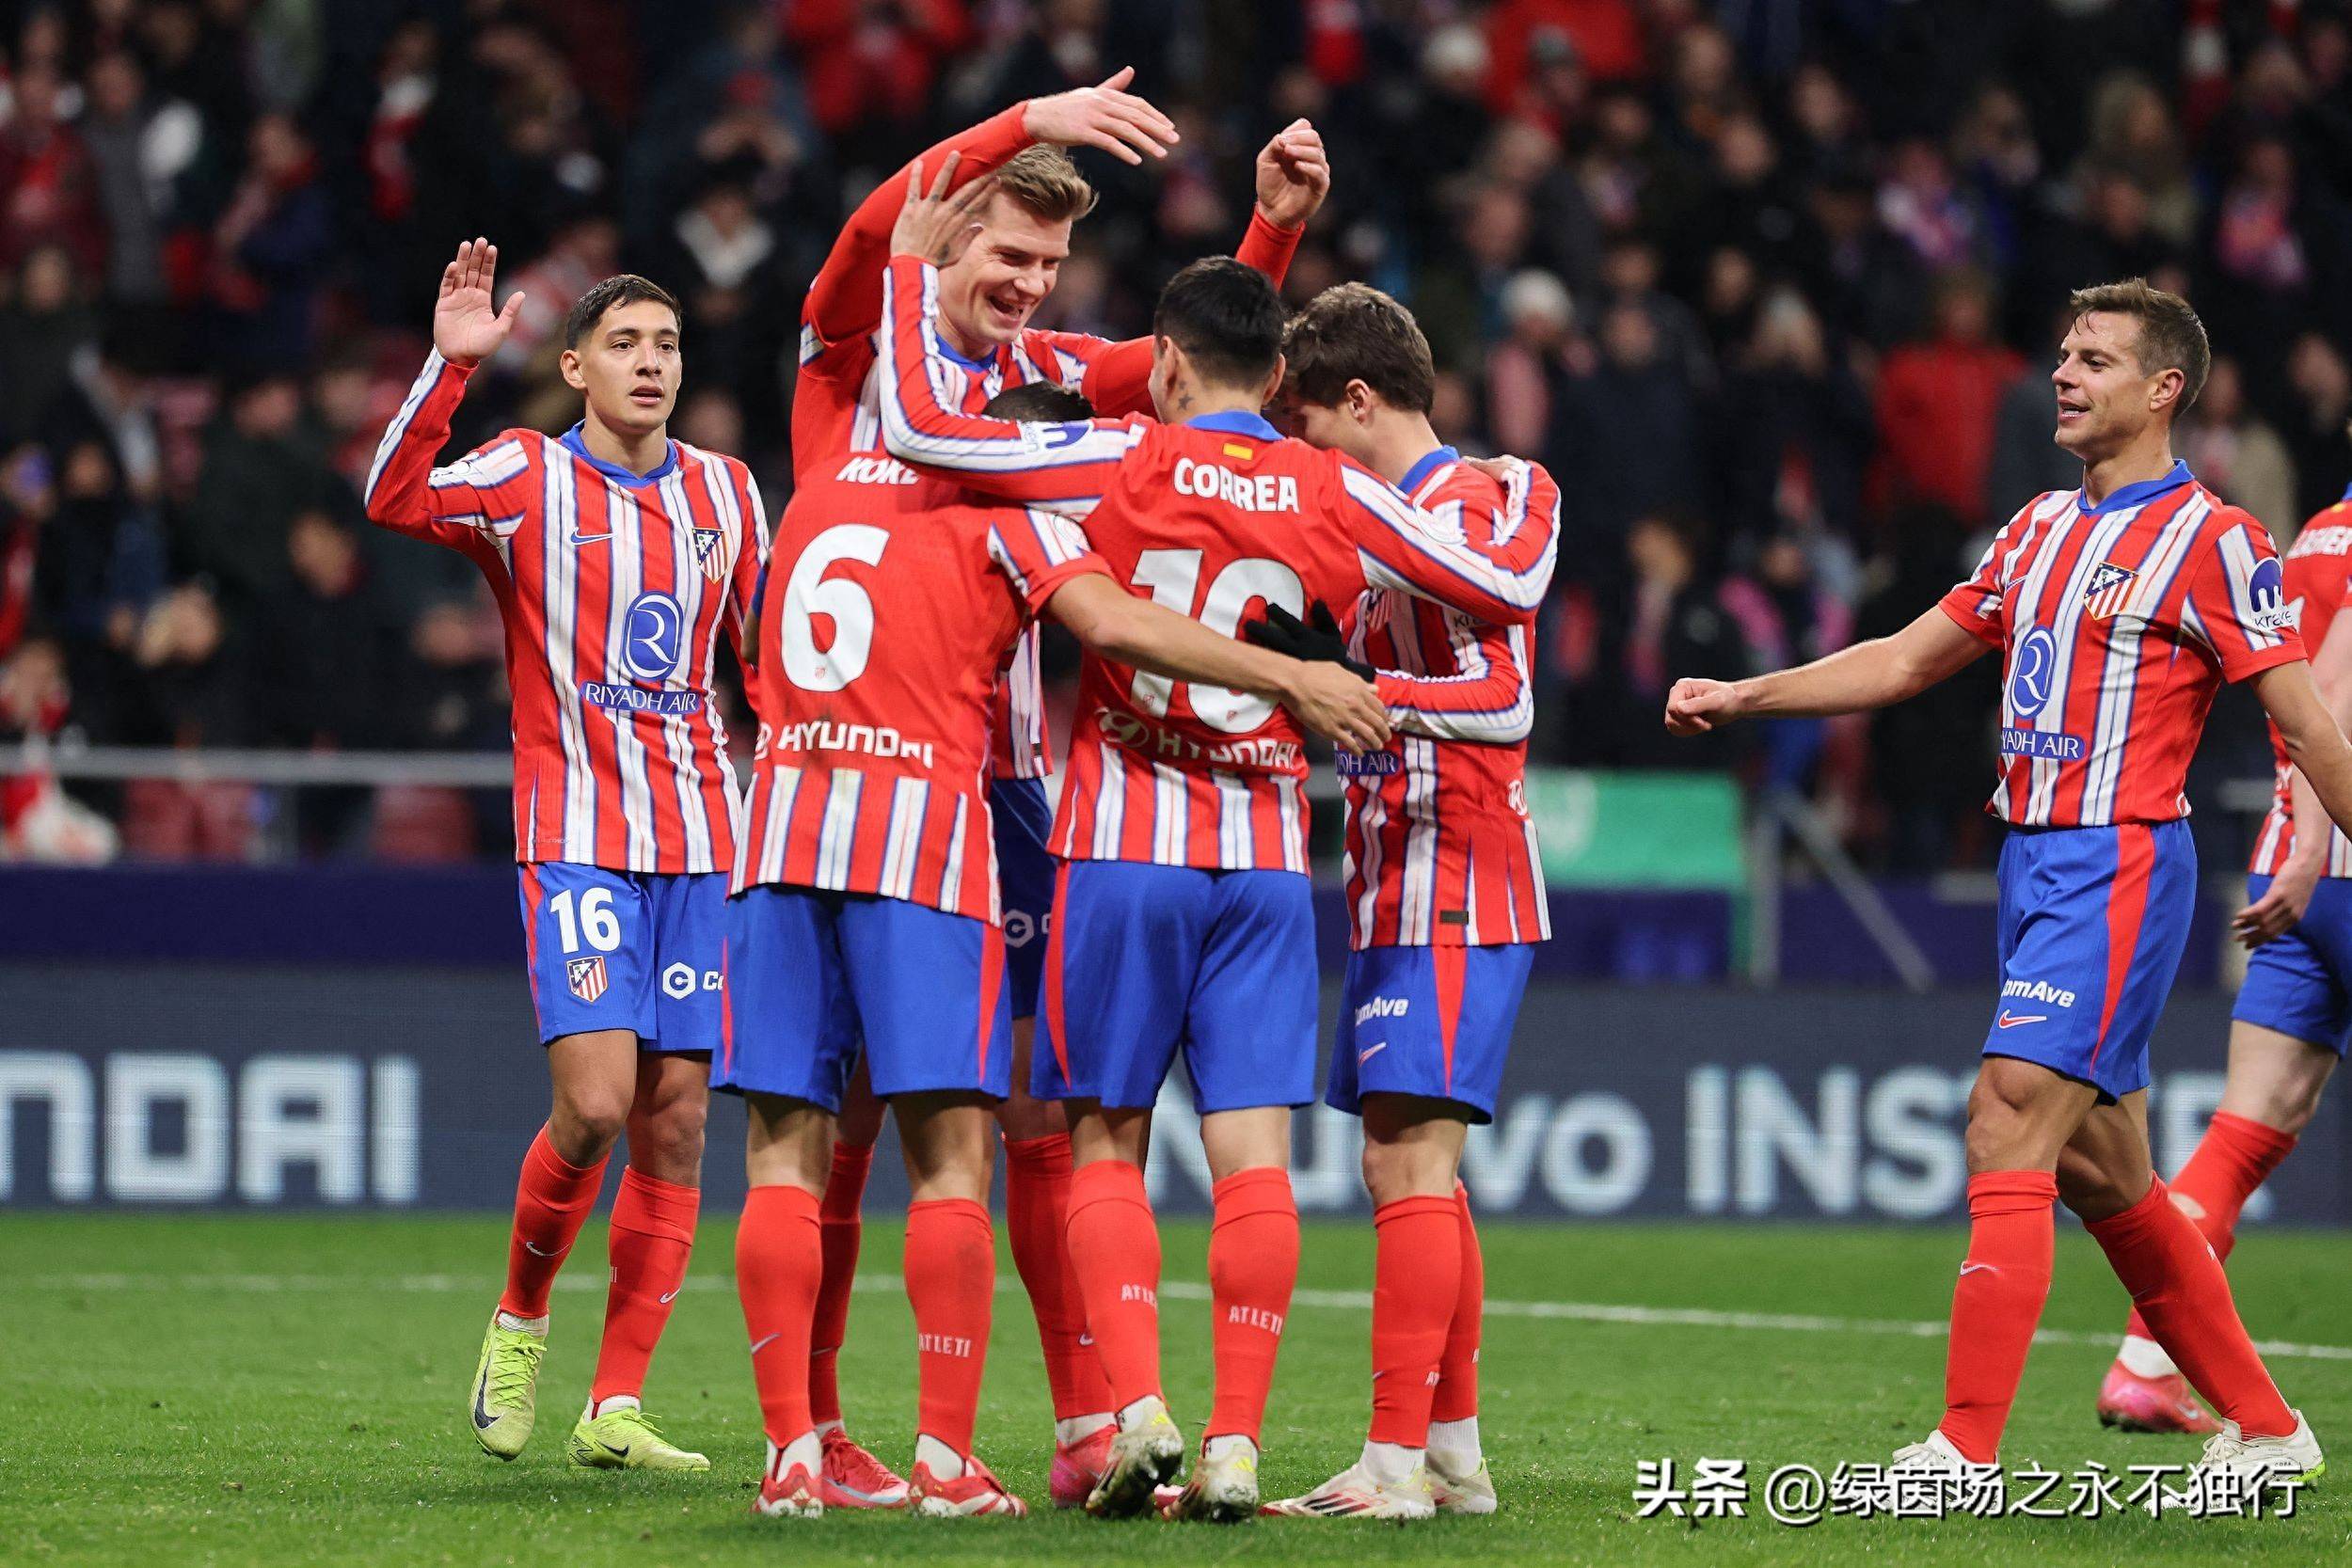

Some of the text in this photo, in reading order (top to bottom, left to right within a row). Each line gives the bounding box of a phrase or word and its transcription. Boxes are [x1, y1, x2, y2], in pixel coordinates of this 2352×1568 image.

[1174, 457, 1299, 514] CORREA
[781, 524, 890, 692] 6
[1131, 549, 1304, 735] 10
[585, 683, 696, 712] RIYADH AIR
[1368, 753, 1395, 772] AIR
[2041, 736, 2078, 758] AIR
[550, 888, 621, 954] 16
[0, 1051, 420, 1202] NDAI
[1229, 1306, 1283, 1336] ATLETI
